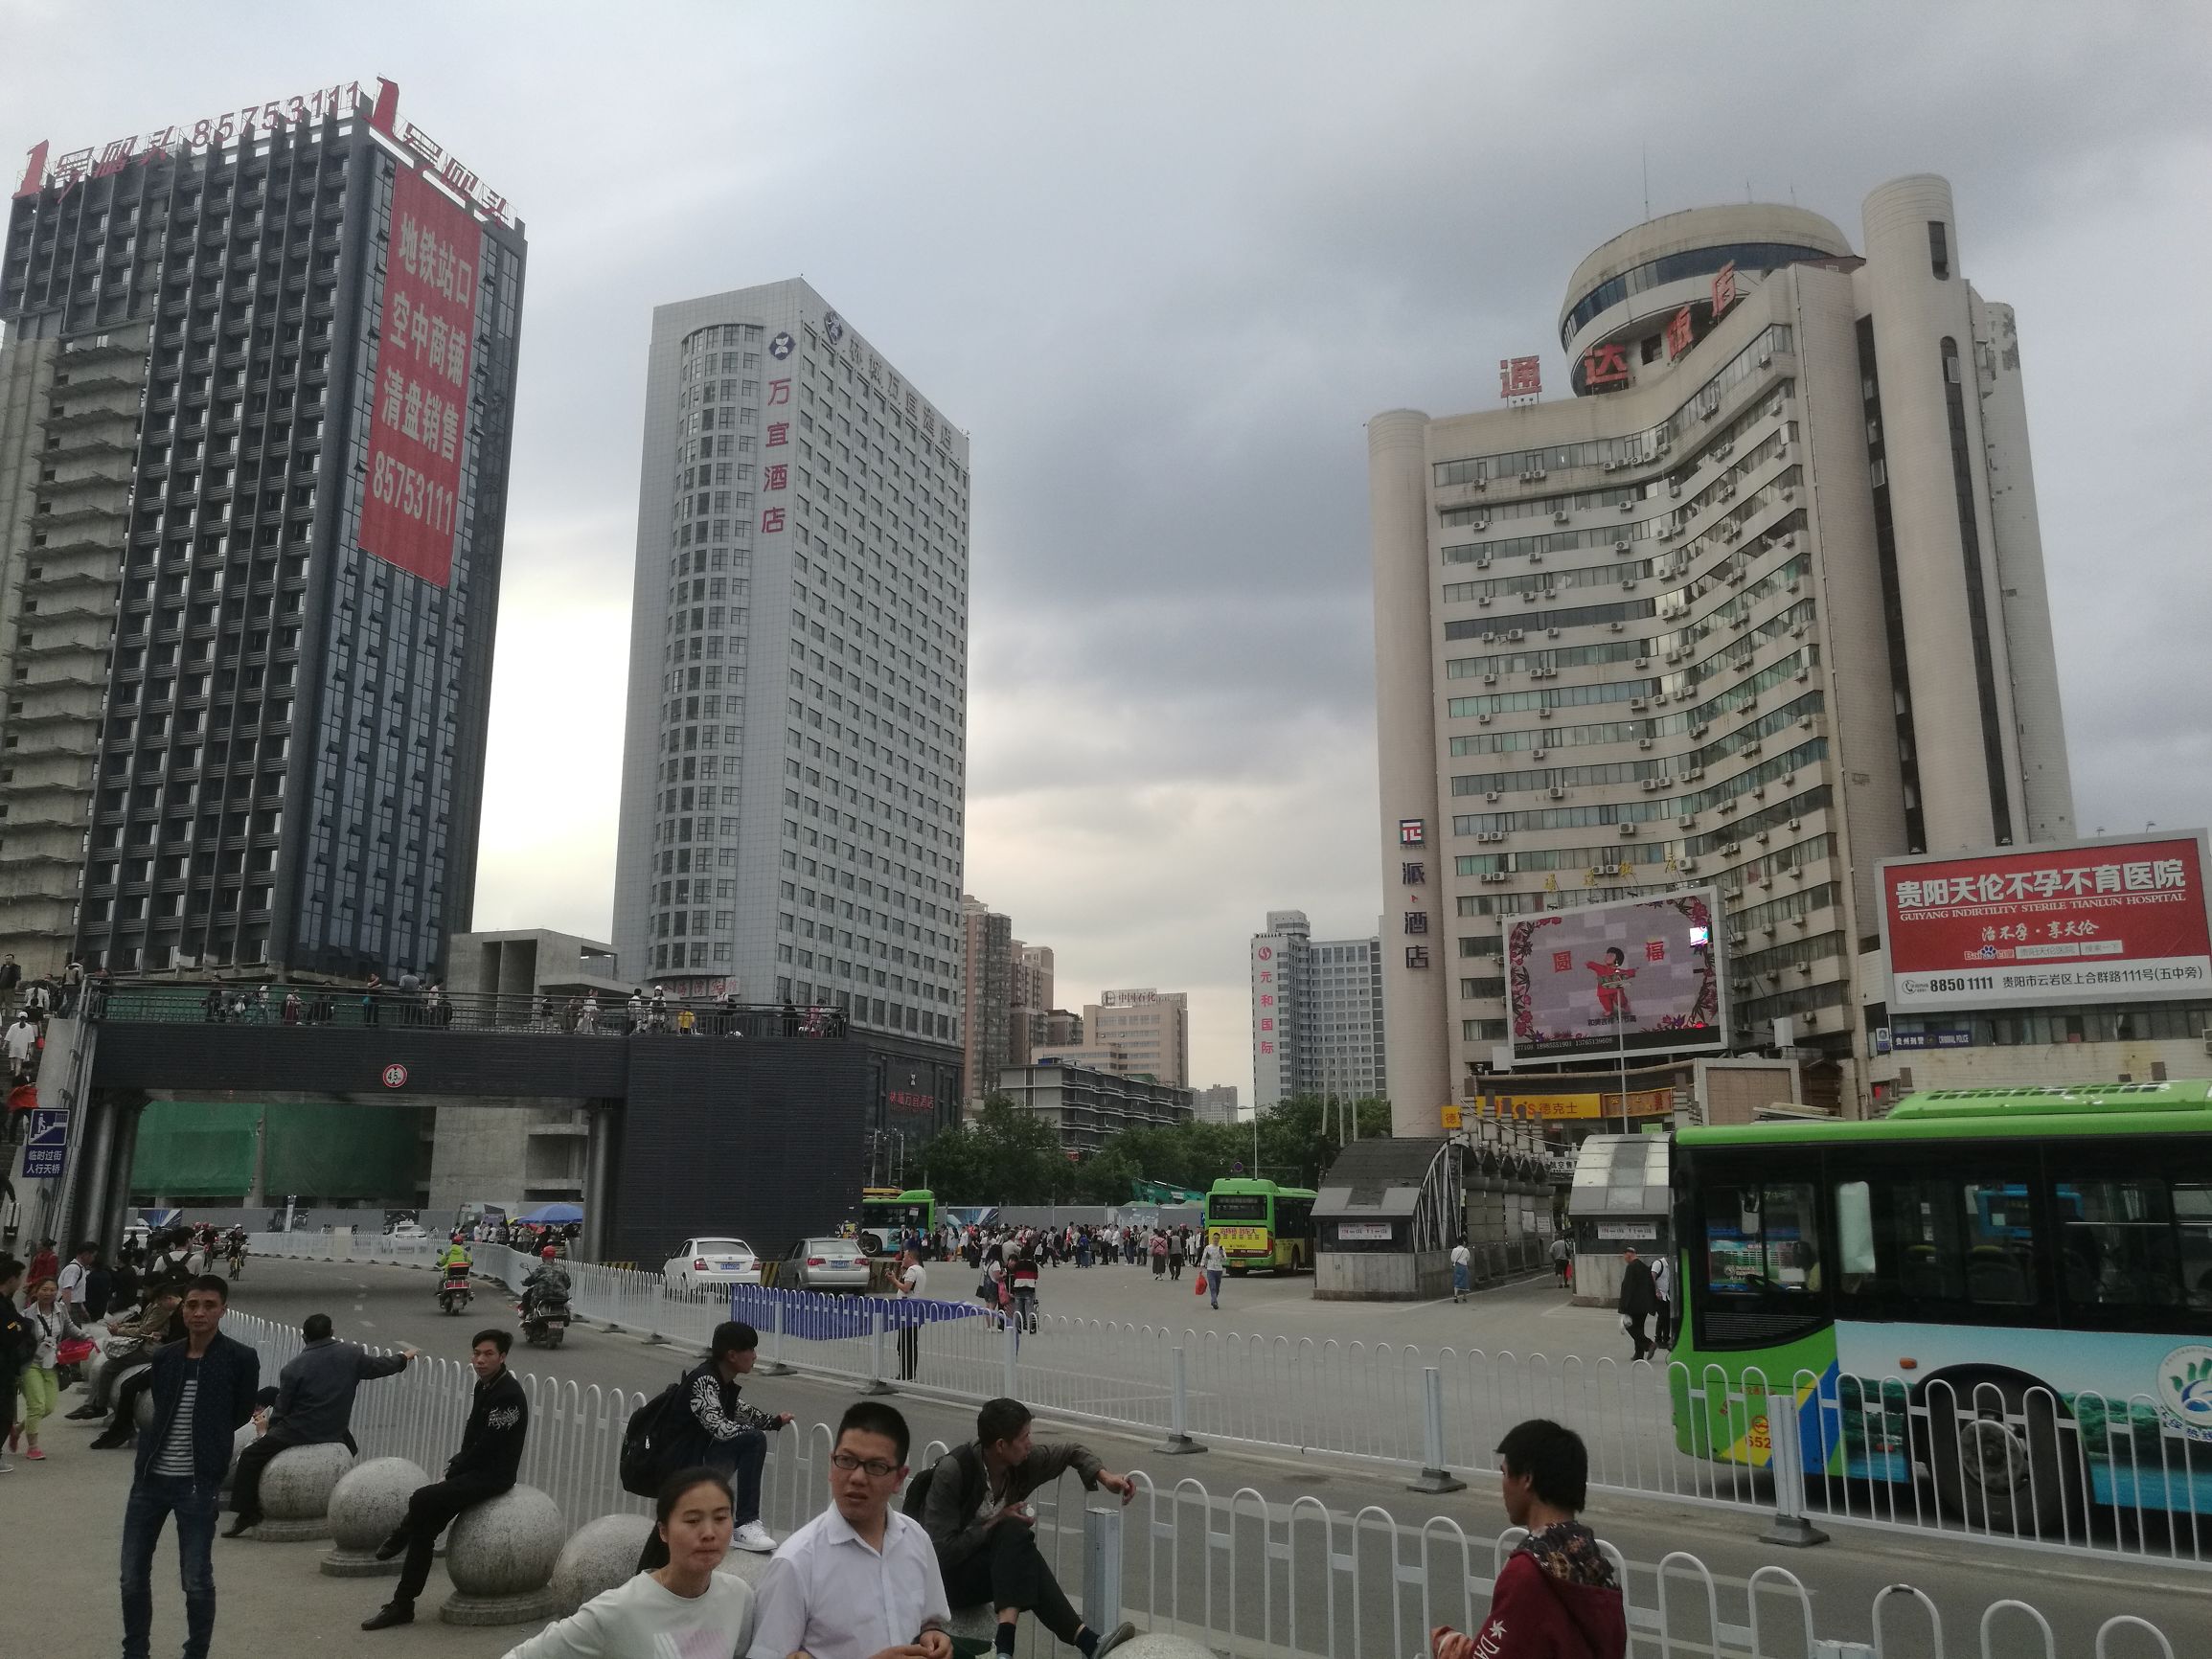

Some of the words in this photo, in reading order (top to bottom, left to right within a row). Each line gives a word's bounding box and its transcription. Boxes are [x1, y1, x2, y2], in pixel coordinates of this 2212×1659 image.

[192, 80, 360, 149] 85753111
[399, 212, 472, 310] 地铁站口
[389, 291, 467, 388] 空中商铺
[381, 365, 460, 464] 清盘销售
[762, 377, 792, 534] 万宜酒店
[373, 451, 454, 535] 85753111
[1896, 859, 2186, 909] 贵阳天伦不孕不育医院
[1900, 910, 1949, 921] GUIYANG
[2021, 902, 2066, 912] STERILE
[2073, 898, 2123, 908] TIANLUN
[2127, 893, 2186, 904] HOSPITAL
[1553, 950, 1572, 973] 圆
[1646, 941, 1665, 962] 福
[1929, 978, 1965, 992] 8850
[1967, 976, 1994, 990] 1111
[1260, 971, 1274, 1054] 元和国际
[1539, 1102, 1579, 1115] 德克士
[27, 1164, 60, 1174] 人行天桥
[28, 1150, 62, 1161] 临时过街
